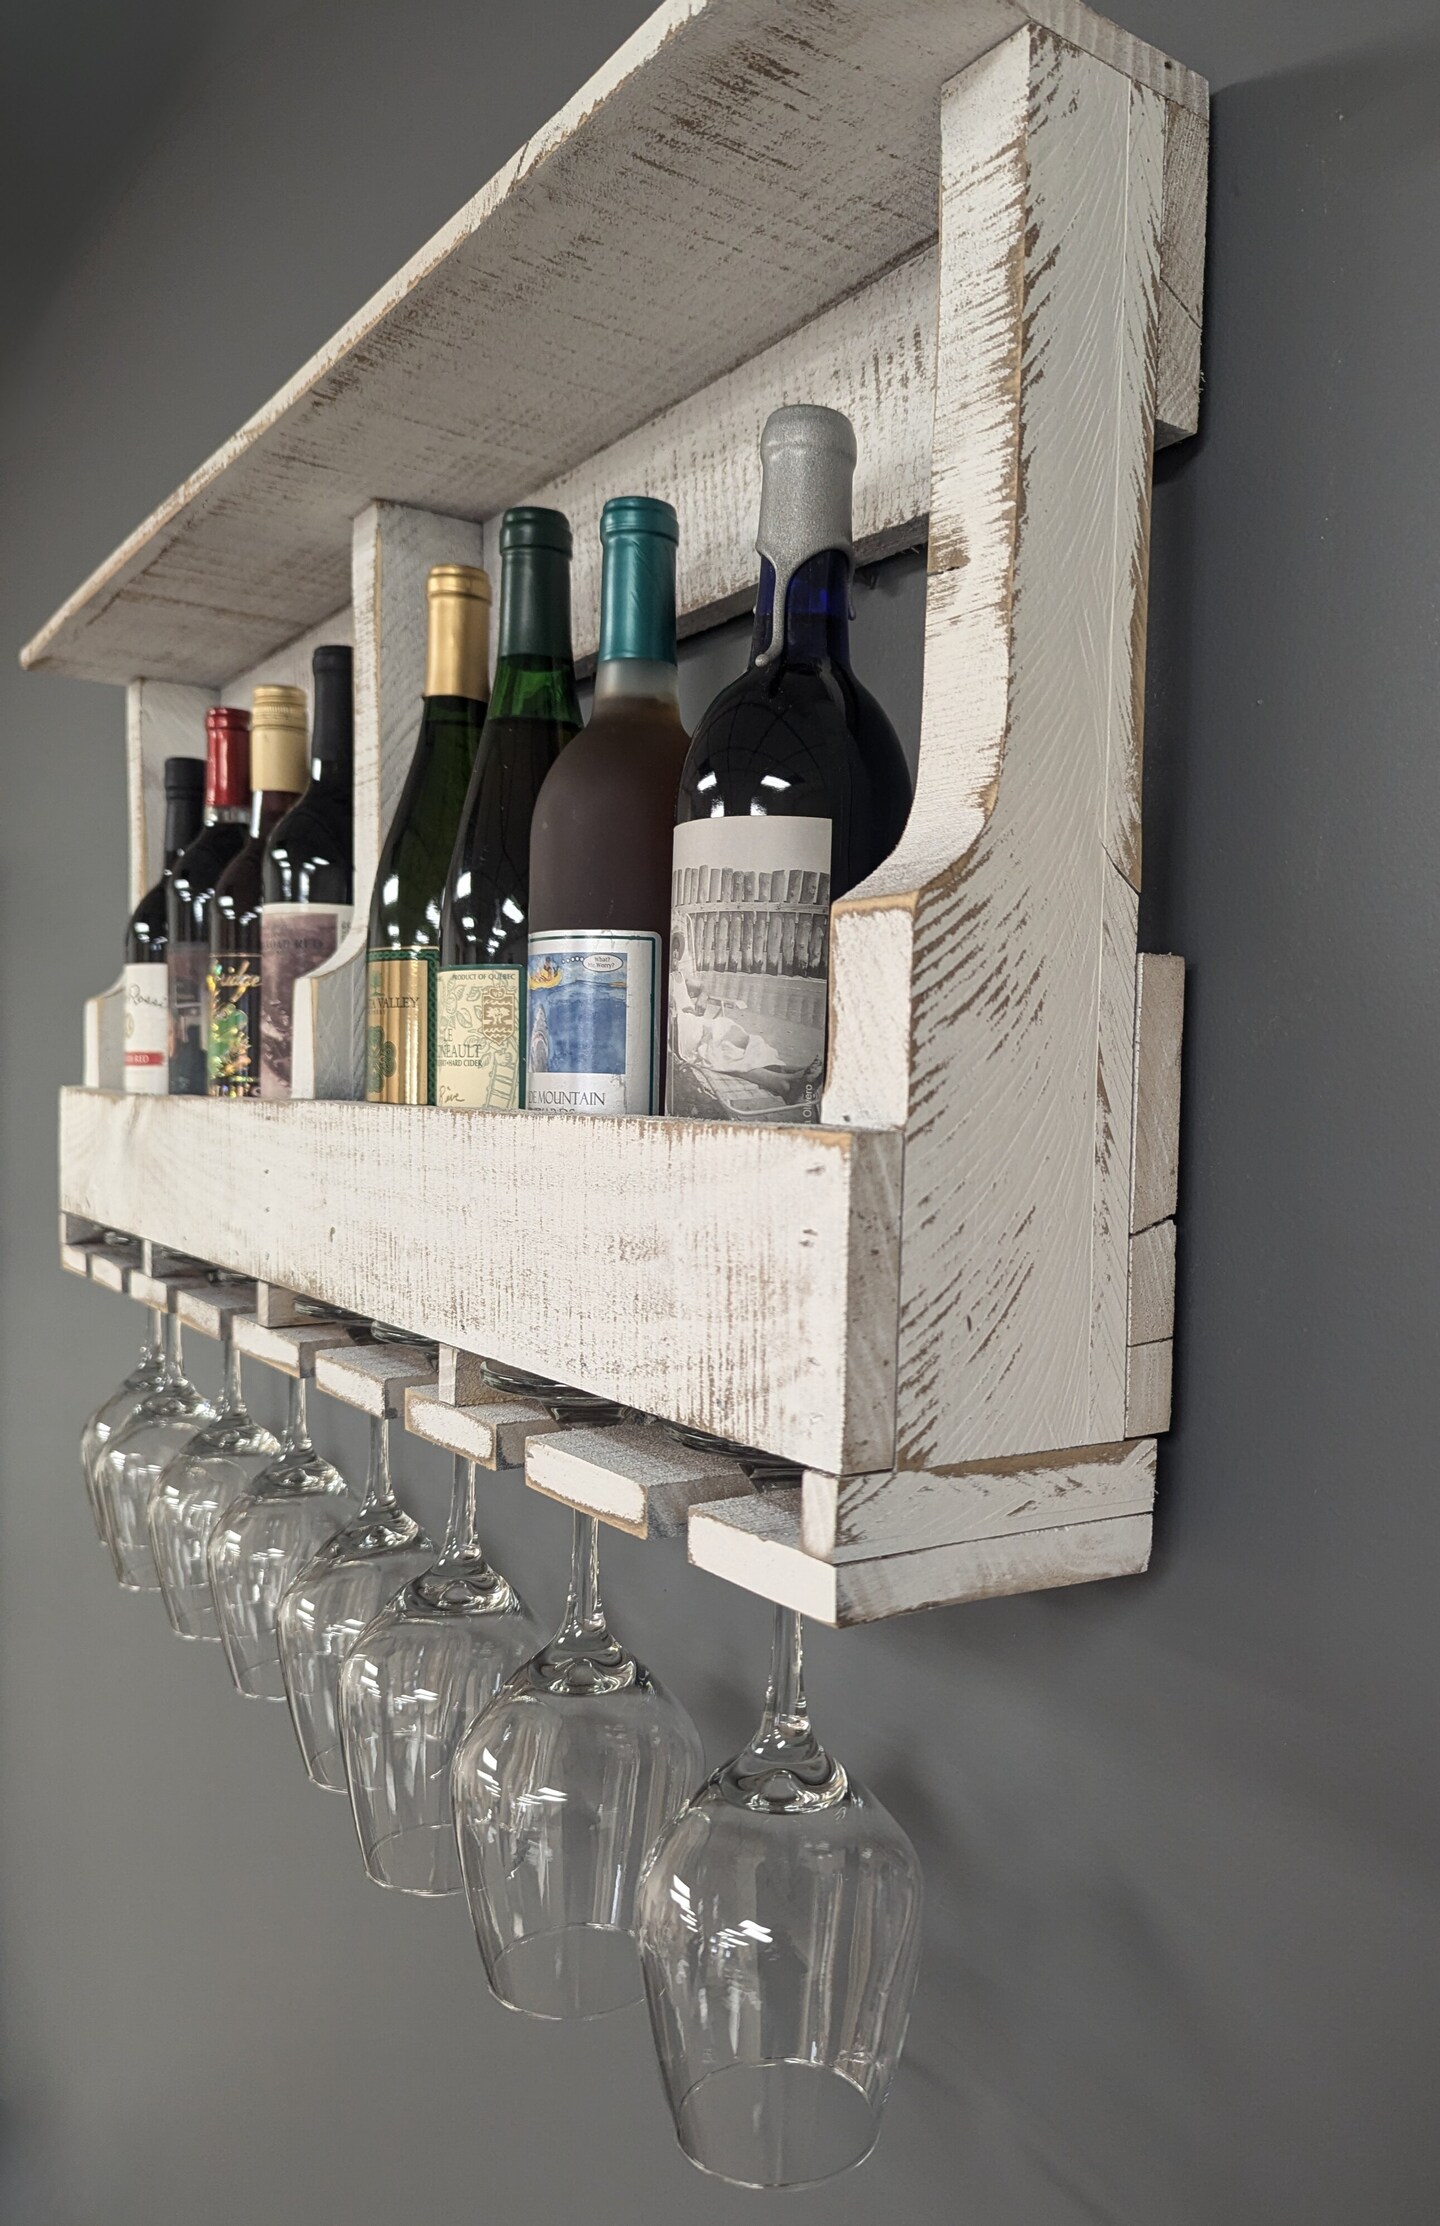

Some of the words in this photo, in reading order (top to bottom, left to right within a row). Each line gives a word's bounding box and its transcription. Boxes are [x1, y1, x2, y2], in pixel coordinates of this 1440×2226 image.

[378, 996, 420, 1009] VALLEY
[463, 1060, 483, 1069] CIDER
[538, 1090, 606, 1106] MOUNTAIN
[802, 1084, 813, 1118] Olivero
